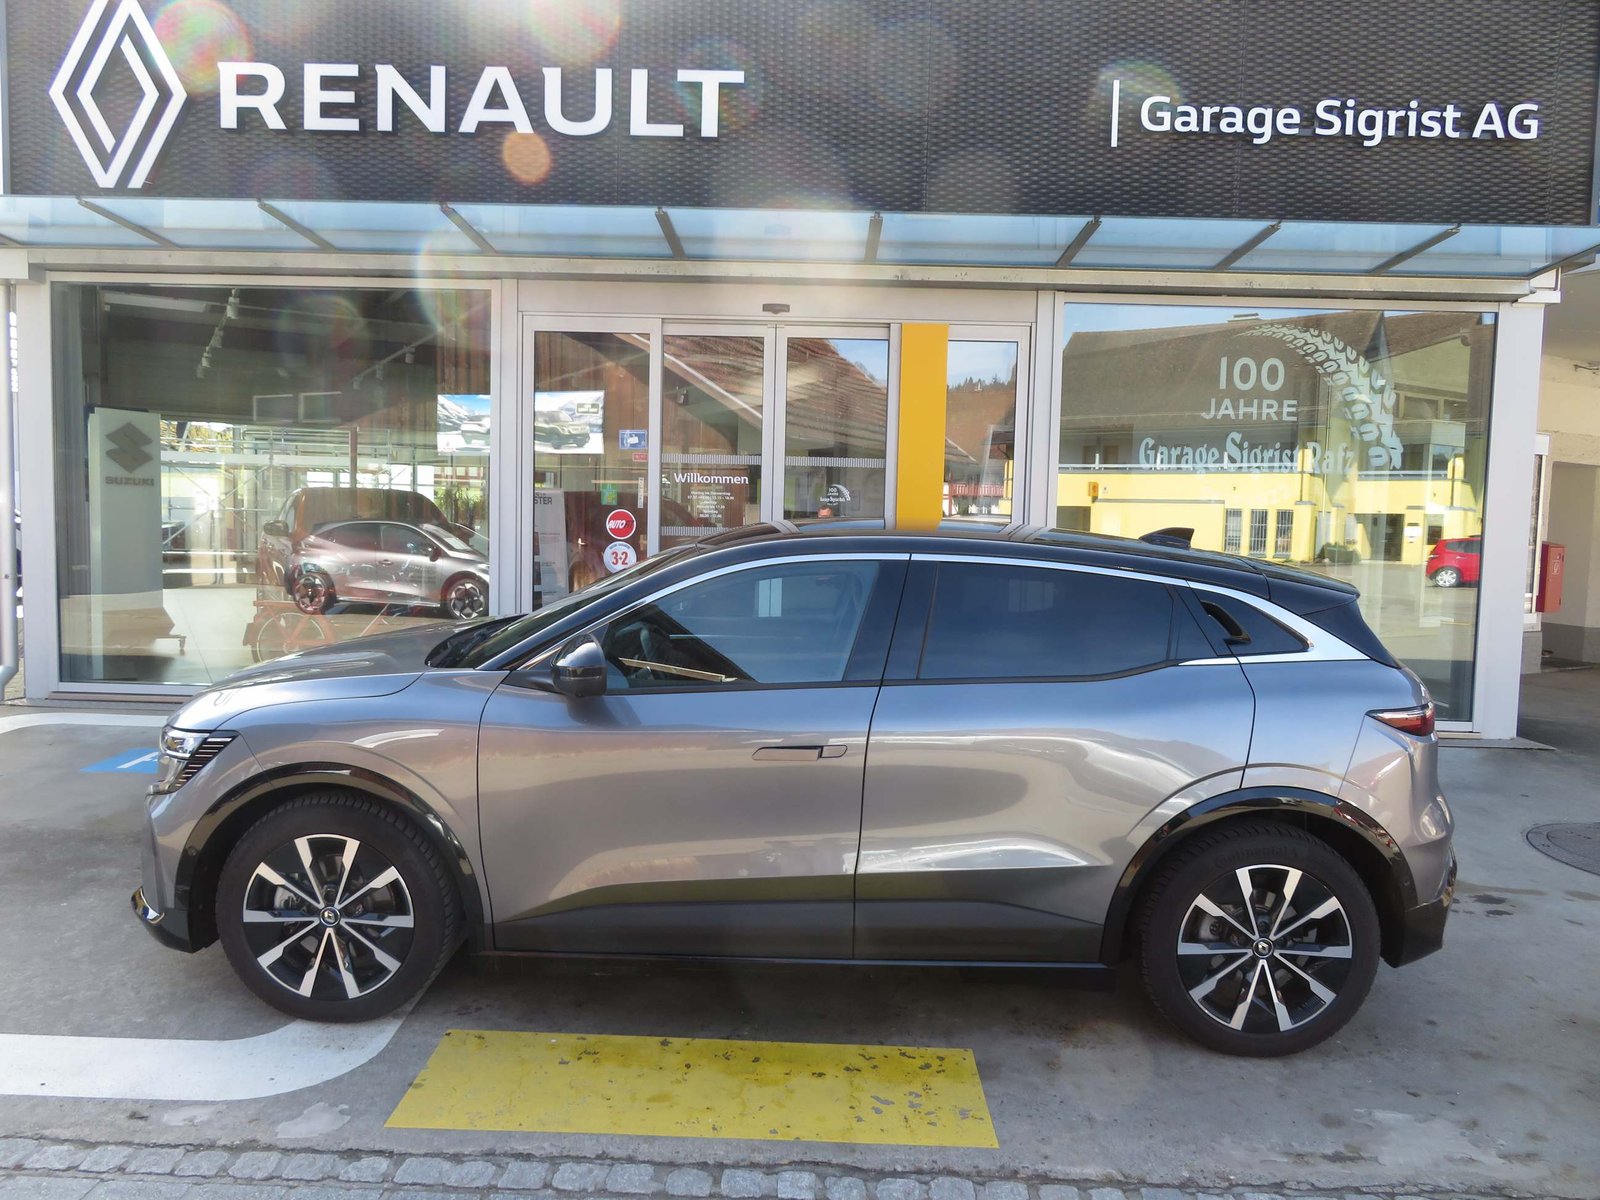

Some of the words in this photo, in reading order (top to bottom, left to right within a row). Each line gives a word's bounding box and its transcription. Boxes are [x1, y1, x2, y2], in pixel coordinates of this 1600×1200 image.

[216, 61, 745, 138] RENAULT
[1140, 94, 1301, 145] Garage
[1315, 98, 1462, 147] Sigrist
[1472, 103, 1539, 140] AG
[1219, 356, 1285, 392] 100
[1201, 398, 1298, 422] JAHRE
[1138, 437, 1220, 474] Garage
[1306, 440, 1355, 475] Rafz
[105, 476, 154, 486] SUZUKI
[674, 472, 749, 484] Willkommen
